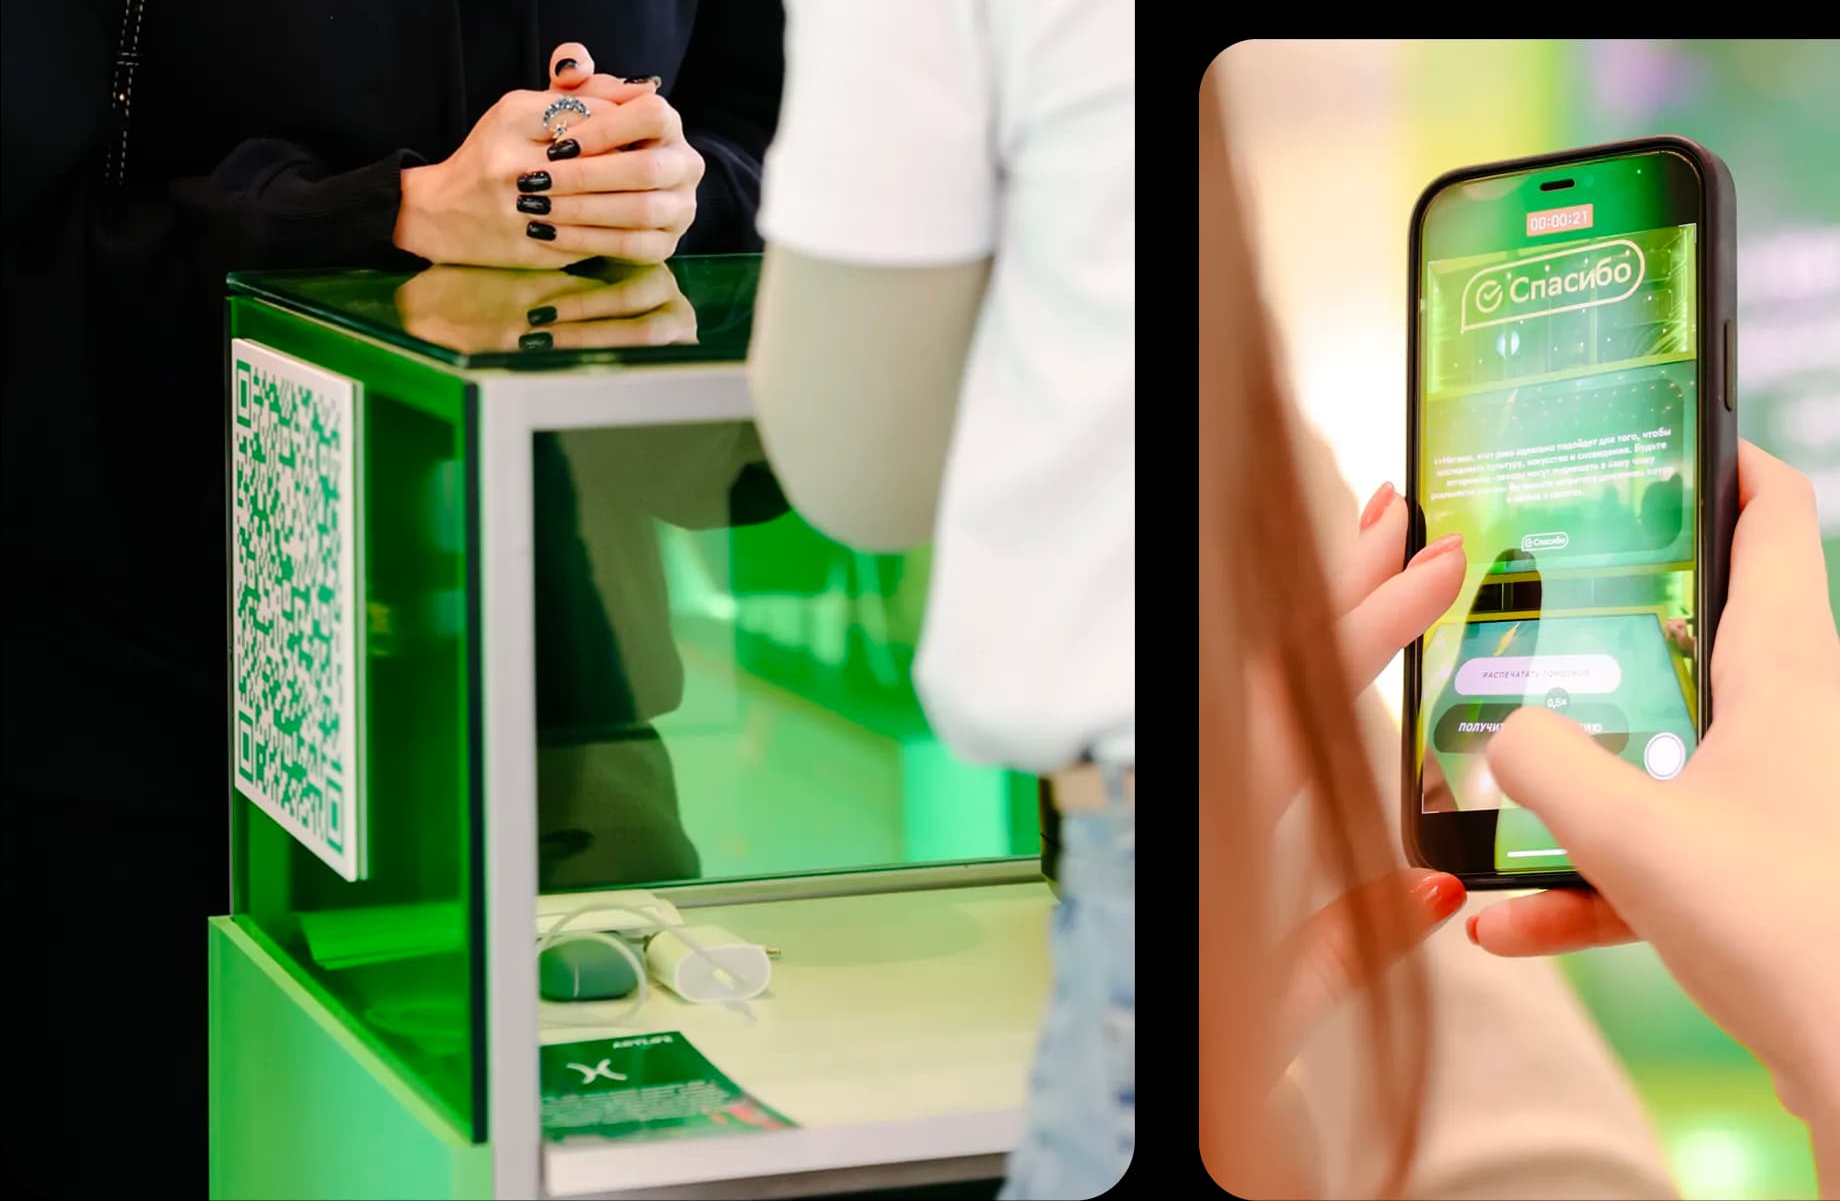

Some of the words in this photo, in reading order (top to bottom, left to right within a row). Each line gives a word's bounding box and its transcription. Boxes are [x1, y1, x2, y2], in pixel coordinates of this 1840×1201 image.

[1530, 210, 1588, 231] 00:00:21
[1510, 257, 1632, 303] Спасибо
[1617, 433, 1640, 442] того,
[1643, 427, 1671, 438] чтобы
